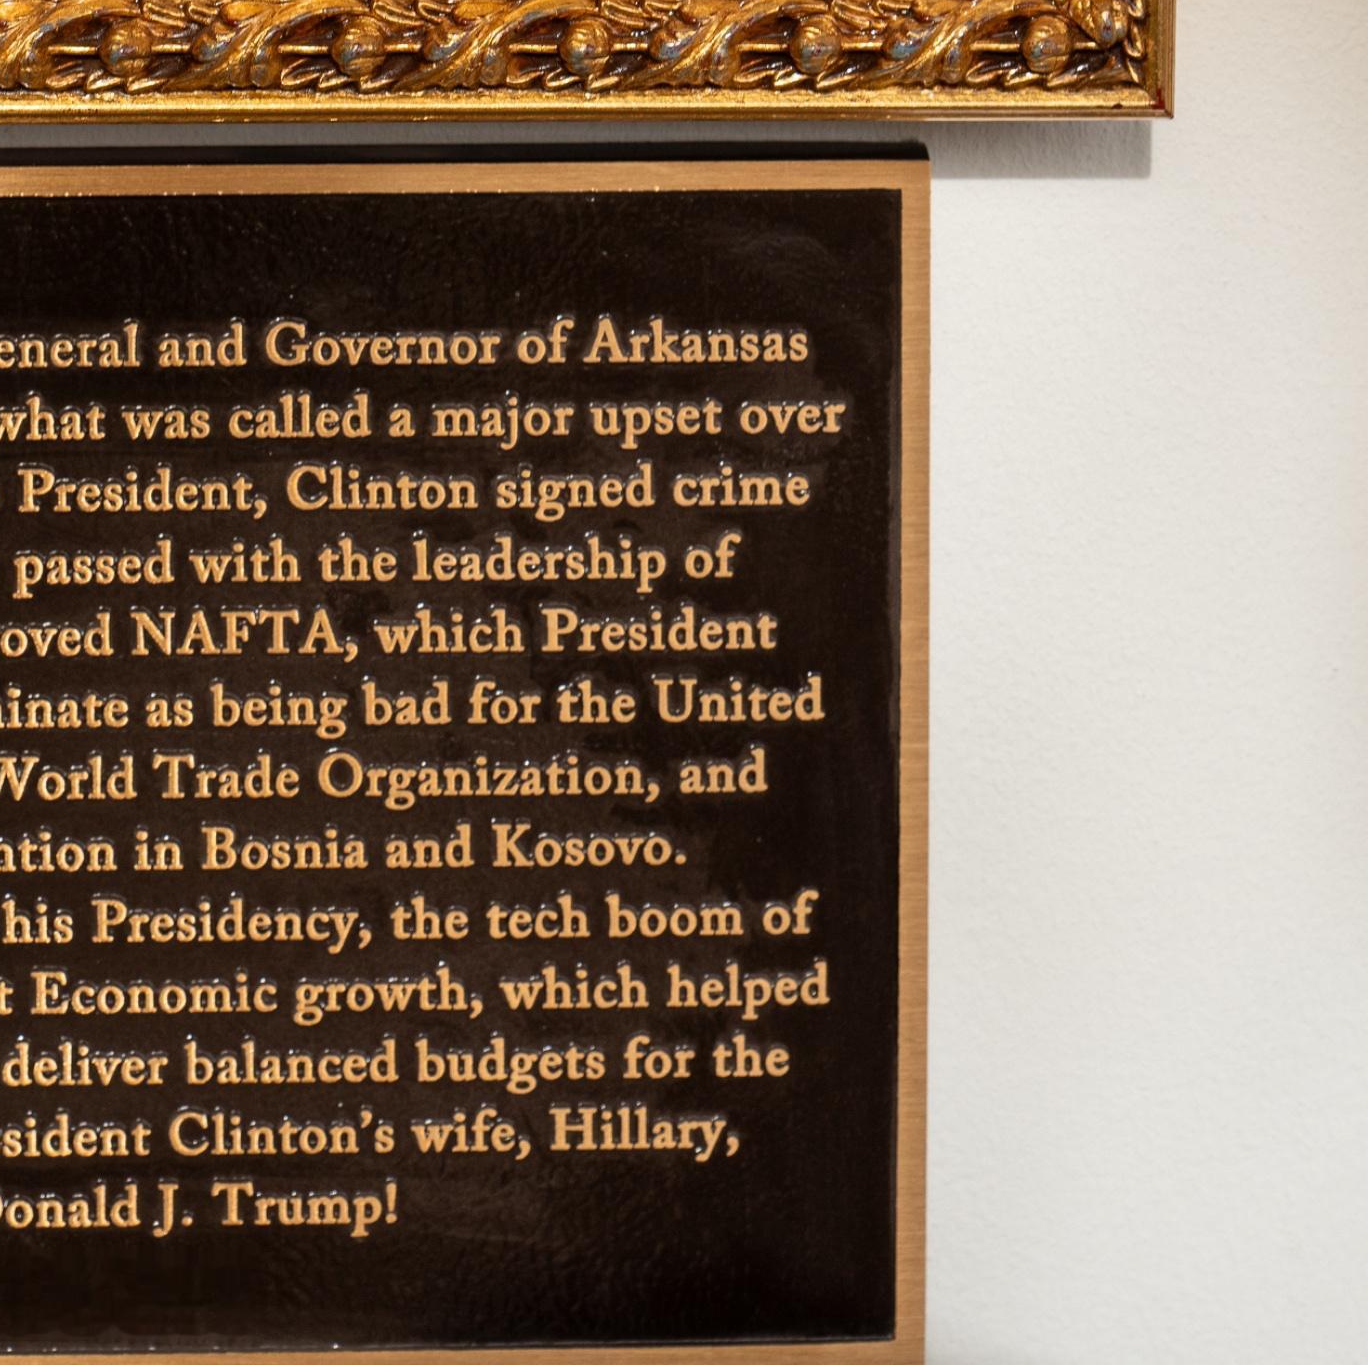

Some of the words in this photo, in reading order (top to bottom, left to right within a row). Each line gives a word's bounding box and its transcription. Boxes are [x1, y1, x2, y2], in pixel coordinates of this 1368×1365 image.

[159, 323, 246, 366] and
[266, 322, 500, 365] Governor
[518, 320, 574, 363] of
[584, 319, 808, 362] Arkansas
[122, 411, 210, 439] was
[229, 394, 371, 438] called
[389, 409, 415, 437] a
[433, 397, 574, 450] major
[590, 401, 722, 449] upset
[740, 404, 845, 433] over
[18, 468, 267, 518] President,
[287, 466, 478, 509] Clinton
[497, 463, 655, 521] signed
[674, 467, 809, 506] crime
[13, 540, 174, 599] passed
[189, 539, 301, 583] with
[319, 538, 396, 581] the
[413, 536, 666, 593] leadership
[685, 533, 741, 578] of
[131, 609, 358, 662] NAFTA,
[374, 609, 524, 653] which
[542, 607, 776, 651] President
[146, 699, 193, 727] as
[211, 684, 347, 739] being
[362, 681, 451, 725] bad
[468, 681, 541, 724] for
[557, 680, 635, 722] the
[654, 677, 824, 722] United
[153, 754, 299, 798] Trade
[319, 753, 659, 810] Organization,
[680, 749, 767, 793] and
[134, 831, 183, 870] in
[202, 827, 368, 869] Bosnia
[386, 824, 474, 868] and
[492, 824, 686, 866] Kosovo.
[2, 900, 73, 943] his
[92, 899, 371, 953] Presidency,
[391, 896, 468, 939] the
[487, 895, 590, 938] tech
[606, 894, 743, 937] boom
[763, 890, 818, 934] of
[31, 972, 277, 1014] Economic
[294, 967, 482, 1026] growth,
[500, 965, 648, 1009] which
[667, 962, 829, 1020] helped
[2, 1042, 168, 1086] deliver
[184, 1039, 398, 1084] balanced
[415, 1038, 605, 1094] budgets
[624, 1036, 694, 1078] for
[713, 1035, 788, 1077] the
[411, 1109, 530, 1159] wife,
[550, 1107, 738, 1161] Hillary,
[154, 1184, 192, 1237] J.
[212, 1182, 396, 1237] Trump!
